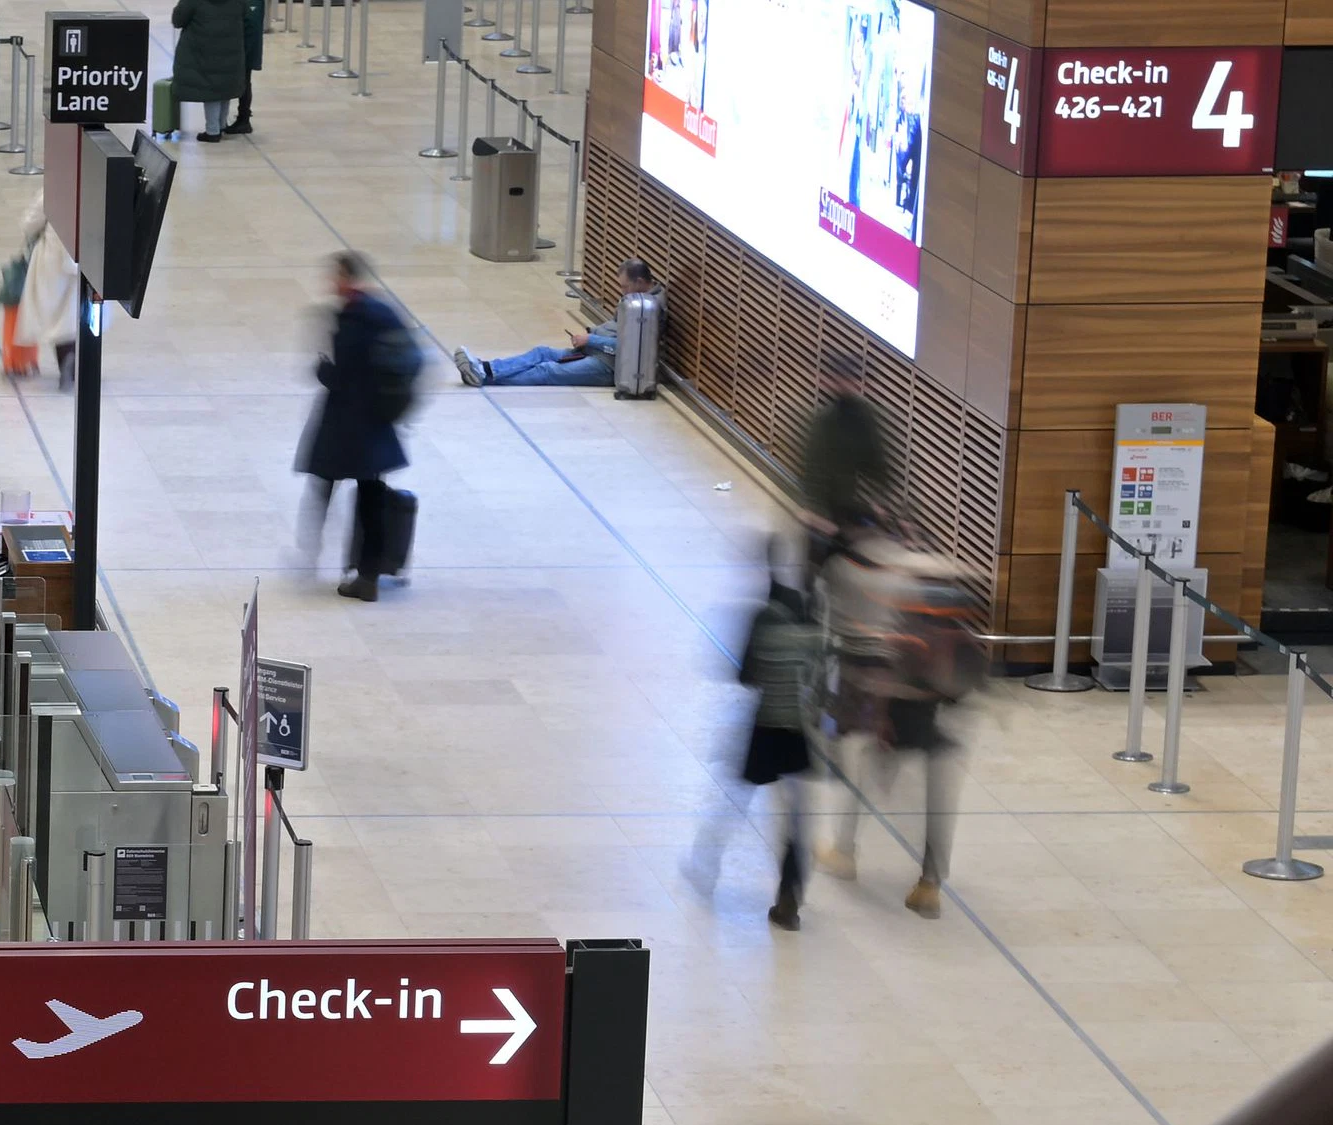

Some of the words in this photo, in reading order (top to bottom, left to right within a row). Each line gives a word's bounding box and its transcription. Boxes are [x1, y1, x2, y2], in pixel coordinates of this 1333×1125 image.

[57, 65, 143, 92] Priority
[1057, 60, 1168, 85] Check-in
[56, 92, 109, 111] Lane
[1003, 57, 1021, 145] 4
[1191, 60, 1254, 148] 4
[820, 187, 856, 245] Shopping
[1151, 411, 1173, 421] BER
[227, 978, 442, 1020] Check-in
